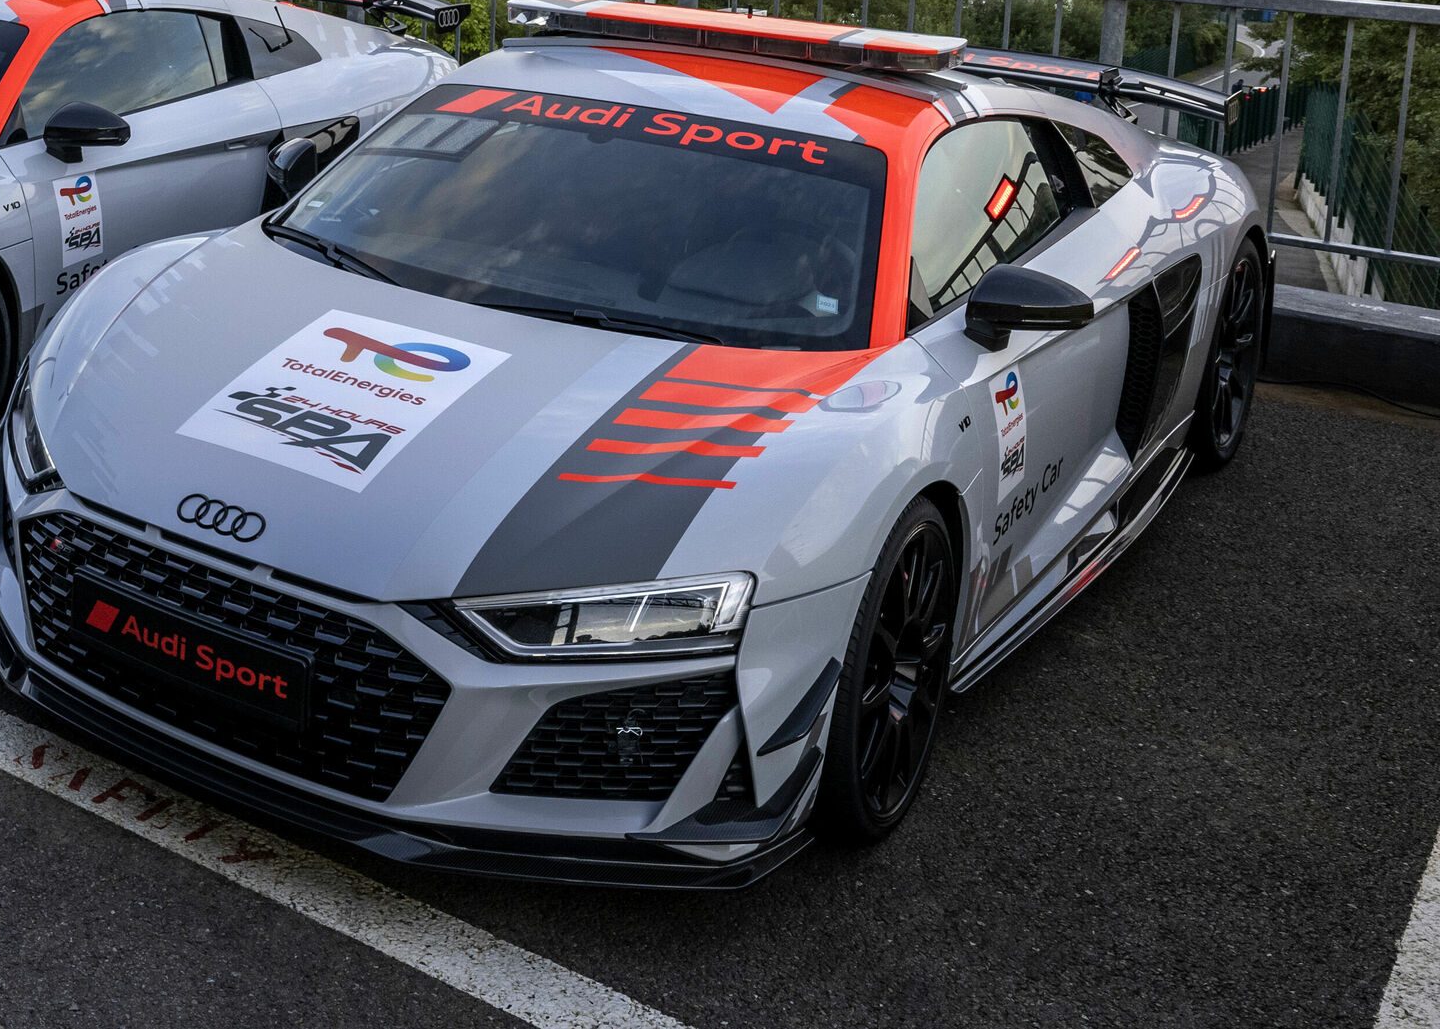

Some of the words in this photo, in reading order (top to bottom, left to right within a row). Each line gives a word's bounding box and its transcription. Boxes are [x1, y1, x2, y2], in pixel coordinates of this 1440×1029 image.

[985, 56, 1100, 81] Sport
[502, 95, 636, 128] Audi
[643, 112, 829, 165] Sport
[3, 201, 21, 212] V10
[64, 205, 97, 221] TotalEnergies
[68, 227, 101, 248] SPA
[281, 357, 426, 407] TotalEnergies
[233, 397, 392, 471] SPA
[281, 394, 320, 409] 24
[319, 405, 407, 436] HOURS
[958, 415, 971, 432] V10
[993, 481, 1039, 546] Safety
[1041, 456, 1064, 493] Car
[121, 615, 186, 661] Audi
[195, 644, 288, 699] Sport
